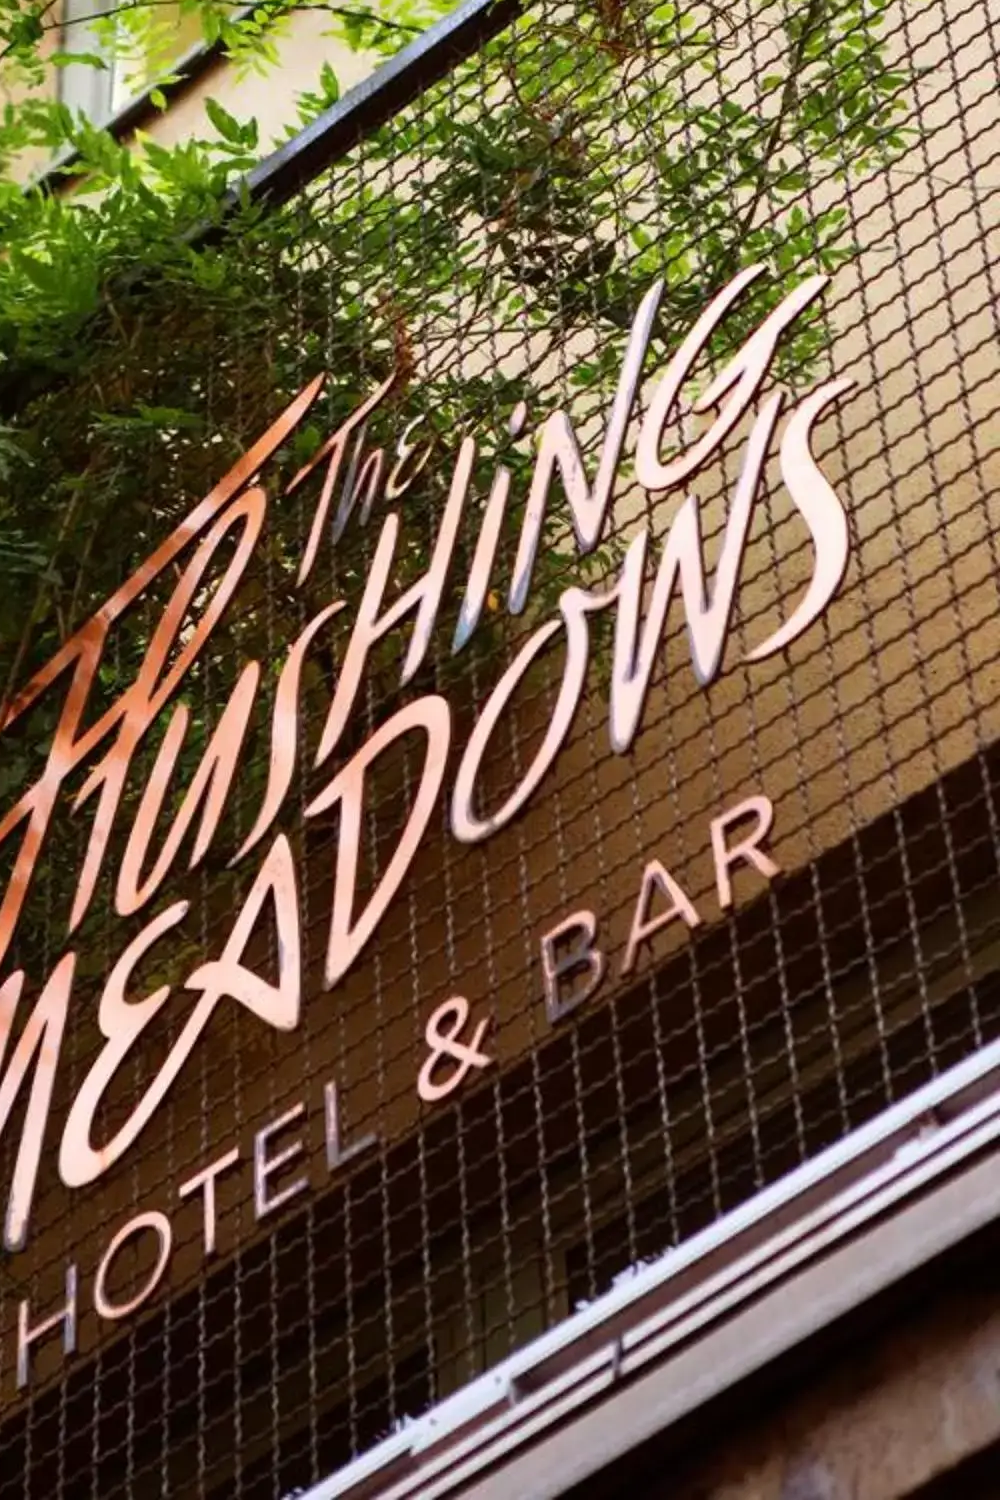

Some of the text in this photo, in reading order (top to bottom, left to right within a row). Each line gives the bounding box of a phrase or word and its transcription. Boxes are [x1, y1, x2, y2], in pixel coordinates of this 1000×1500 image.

[16, 795, 783, 1388] HOTEL & BAR
